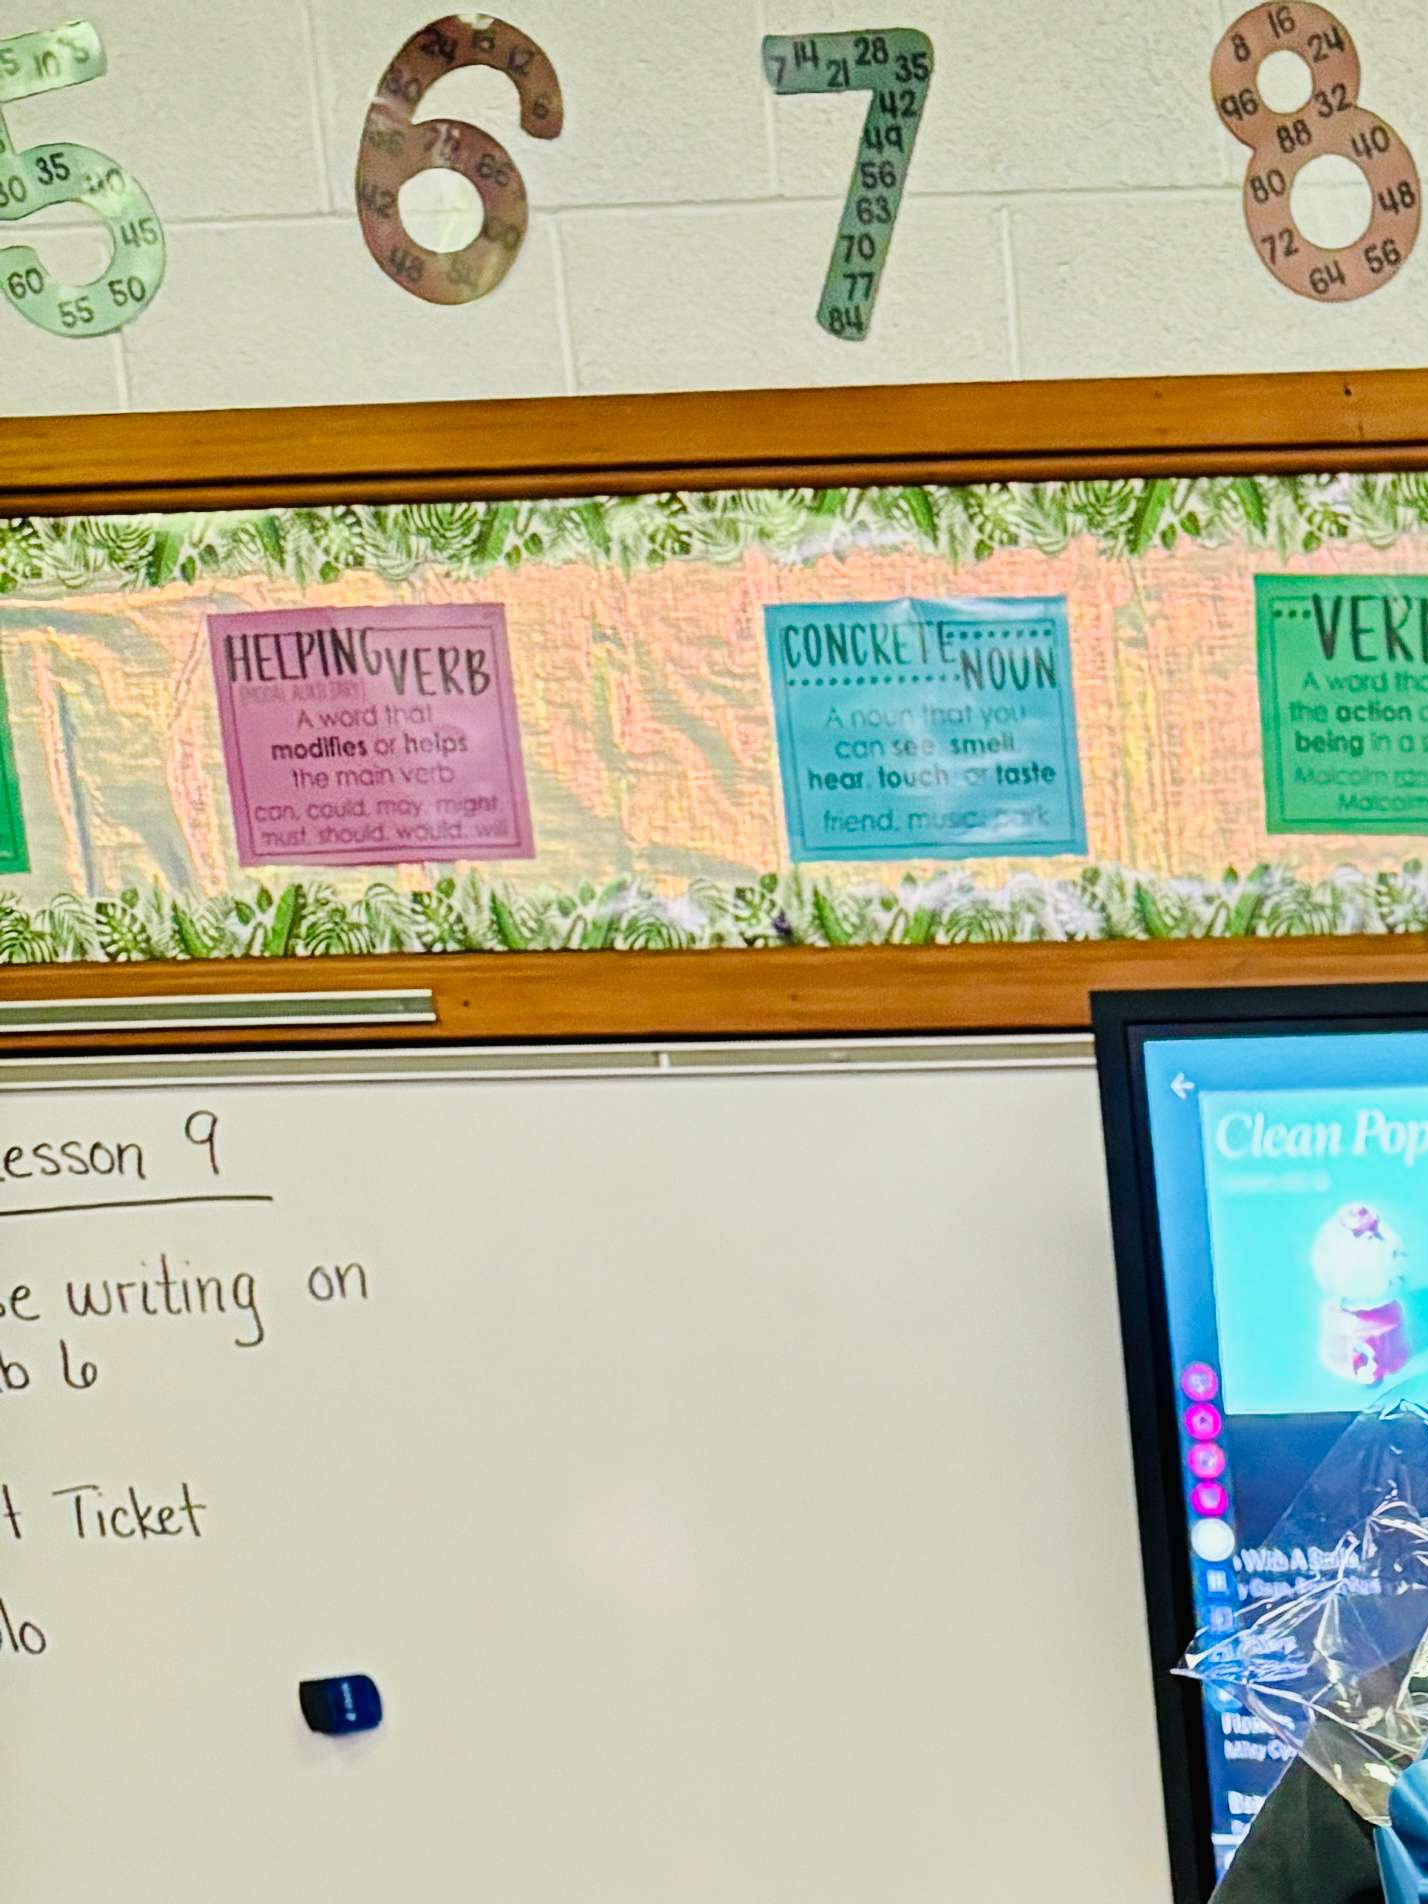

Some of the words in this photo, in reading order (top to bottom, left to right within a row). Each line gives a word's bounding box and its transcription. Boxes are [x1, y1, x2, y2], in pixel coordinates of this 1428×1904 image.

[1267, 6, 1295, 39] 16
[793, 40, 818, 69] 14
[854, 37, 889, 66] 28
[1231, 34, 1250, 63] 8
[1308, 26, 1344, 63] 24
[770, 57, 786, 85] 7
[826, 60, 850, 87] 21
[895, 54, 930, 83] 35
[879, 91, 918, 118] 42
[1221, 89, 1258, 121] 96
[1314, 83, 1351, 118] 32
[863, 126, 905, 153] 49
[1210, 0, 1421, 303] 8
[1276, 120, 1312, 154] 88
[1351, 126, 1390, 159] 40
[36, 153, 70, 186] 35
[355, 14, 564, 306] 6
[861, 162, 896, 189] 56
[763, 27, 934, 341] 7
[1250, 170, 1286, 204] 80
[1378, 181, 1416, 216] 48
[857, 197, 892, 224] 63
[120, 219, 159, 248] 45
[840, 233, 876, 264] 70
[1261, 229, 1299, 265] 72
[1364, 239, 1400, 274] 56
[8, 267, 44, 299] 60
[108, 276, 146, 306] 50
[843, 272, 875, 300] 77
[1309, 260, 1346, 294] 64
[58, 297, 94, 328] 55
[828, 306, 864, 335] 84
[224, 627, 383, 682] HELPING
[385, 647, 491, 696] VERB
[783, 621, 957, 668] CONCRETE
[961, 646, 1057, 691] NOUN
[297, 710, 312, 729] A
[318, 706, 377, 727] word
[1336, 701, 1413, 723] action
[271, 736, 368, 761] modifies
[404, 732, 468, 758] helps
[835, 738, 884, 759] can
[1295, 729, 1364, 757] being
[292, 769, 329, 789] the
[336, 767, 392, 787] main
[401, 763, 455, 784] verb
[996, 761, 1056, 785] taste
[0, 1140, 147, 1183] esson
[184, 1109, 220, 1175] 9
[1215, 1112, 1341, 1161] Clean
[66, 1253, 265, 1348] writing
[307, 1262, 368, 1301] on
[59, 1338, 98, 1389] 6
[52, 1482, 207, 1539] Ticket
